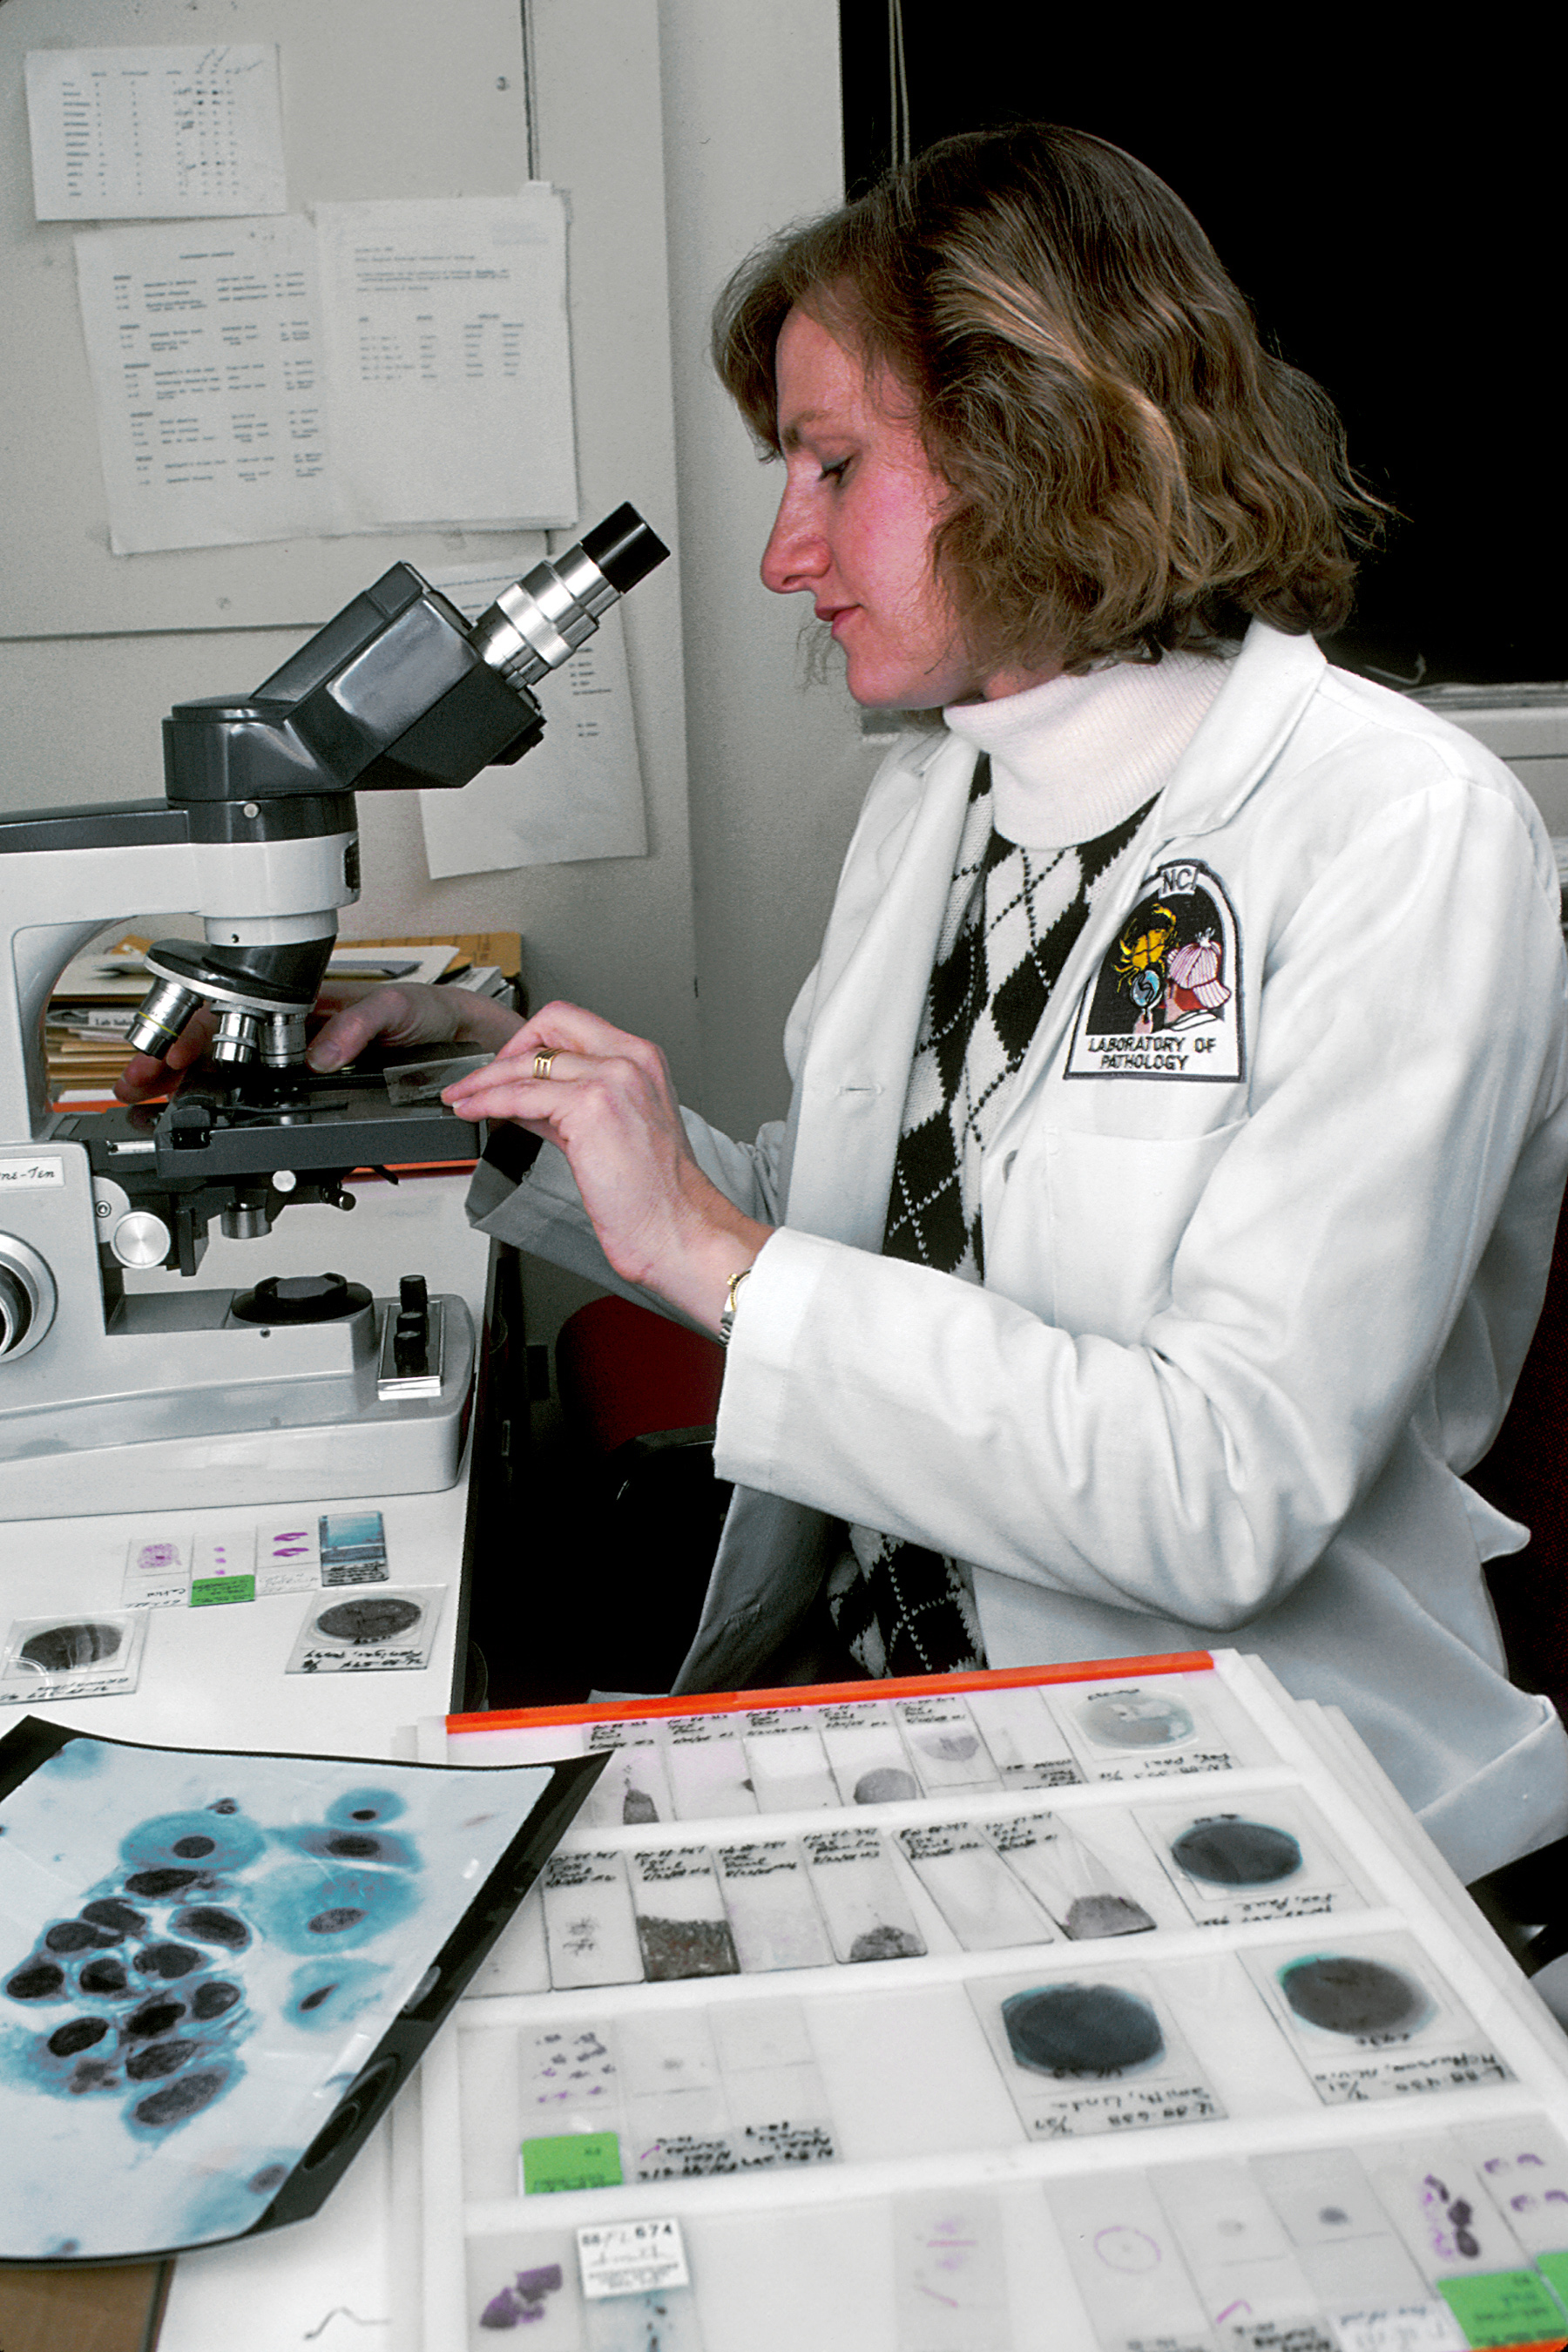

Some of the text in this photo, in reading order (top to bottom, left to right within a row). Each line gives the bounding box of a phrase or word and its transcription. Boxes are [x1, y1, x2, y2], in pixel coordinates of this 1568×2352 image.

[1162, 868, 1198, 896] NCI
[1088, 1037, 1216, 1053] LABORATORY OF
[1100, 1054, 1189, 1071] PATHOLOGY
[0, 1166, 55, 1180] ne-Ten
